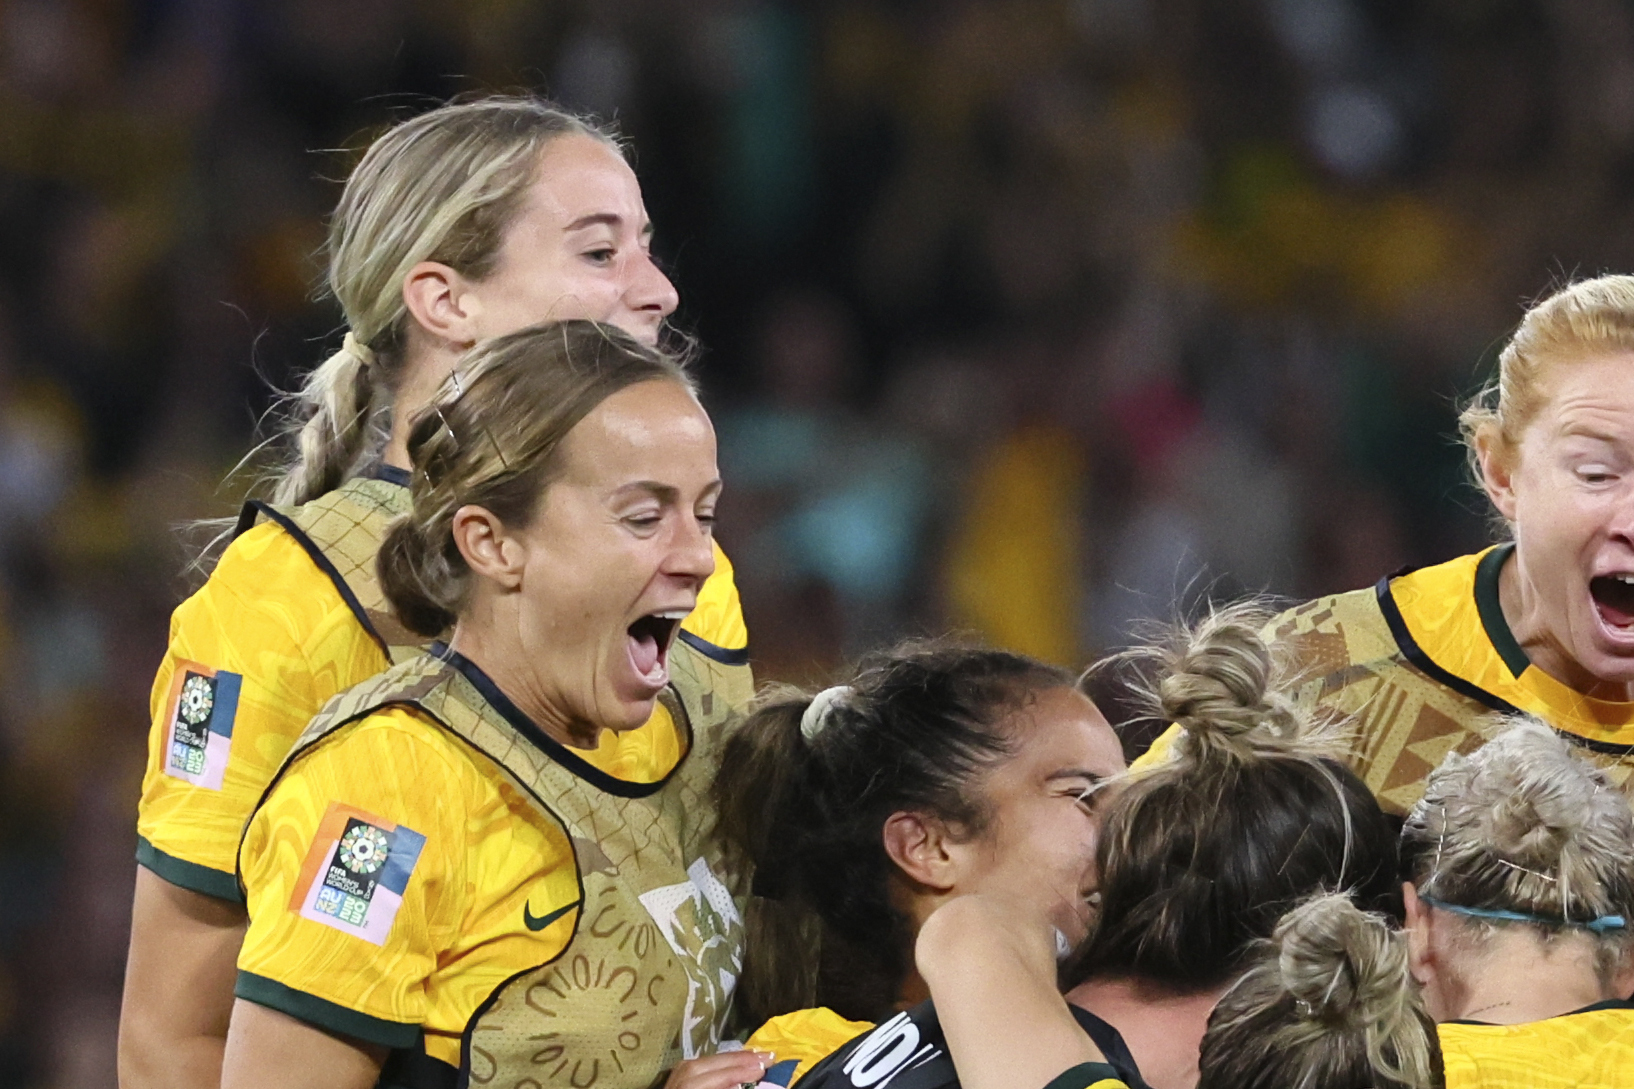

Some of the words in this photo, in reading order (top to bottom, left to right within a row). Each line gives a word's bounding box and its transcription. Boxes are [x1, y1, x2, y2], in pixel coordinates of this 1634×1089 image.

[329, 865, 347, 878] FIFA
[319, 887, 343, 903] AU
[343, 896, 366, 912] 20
[339, 908, 363, 925] 23
